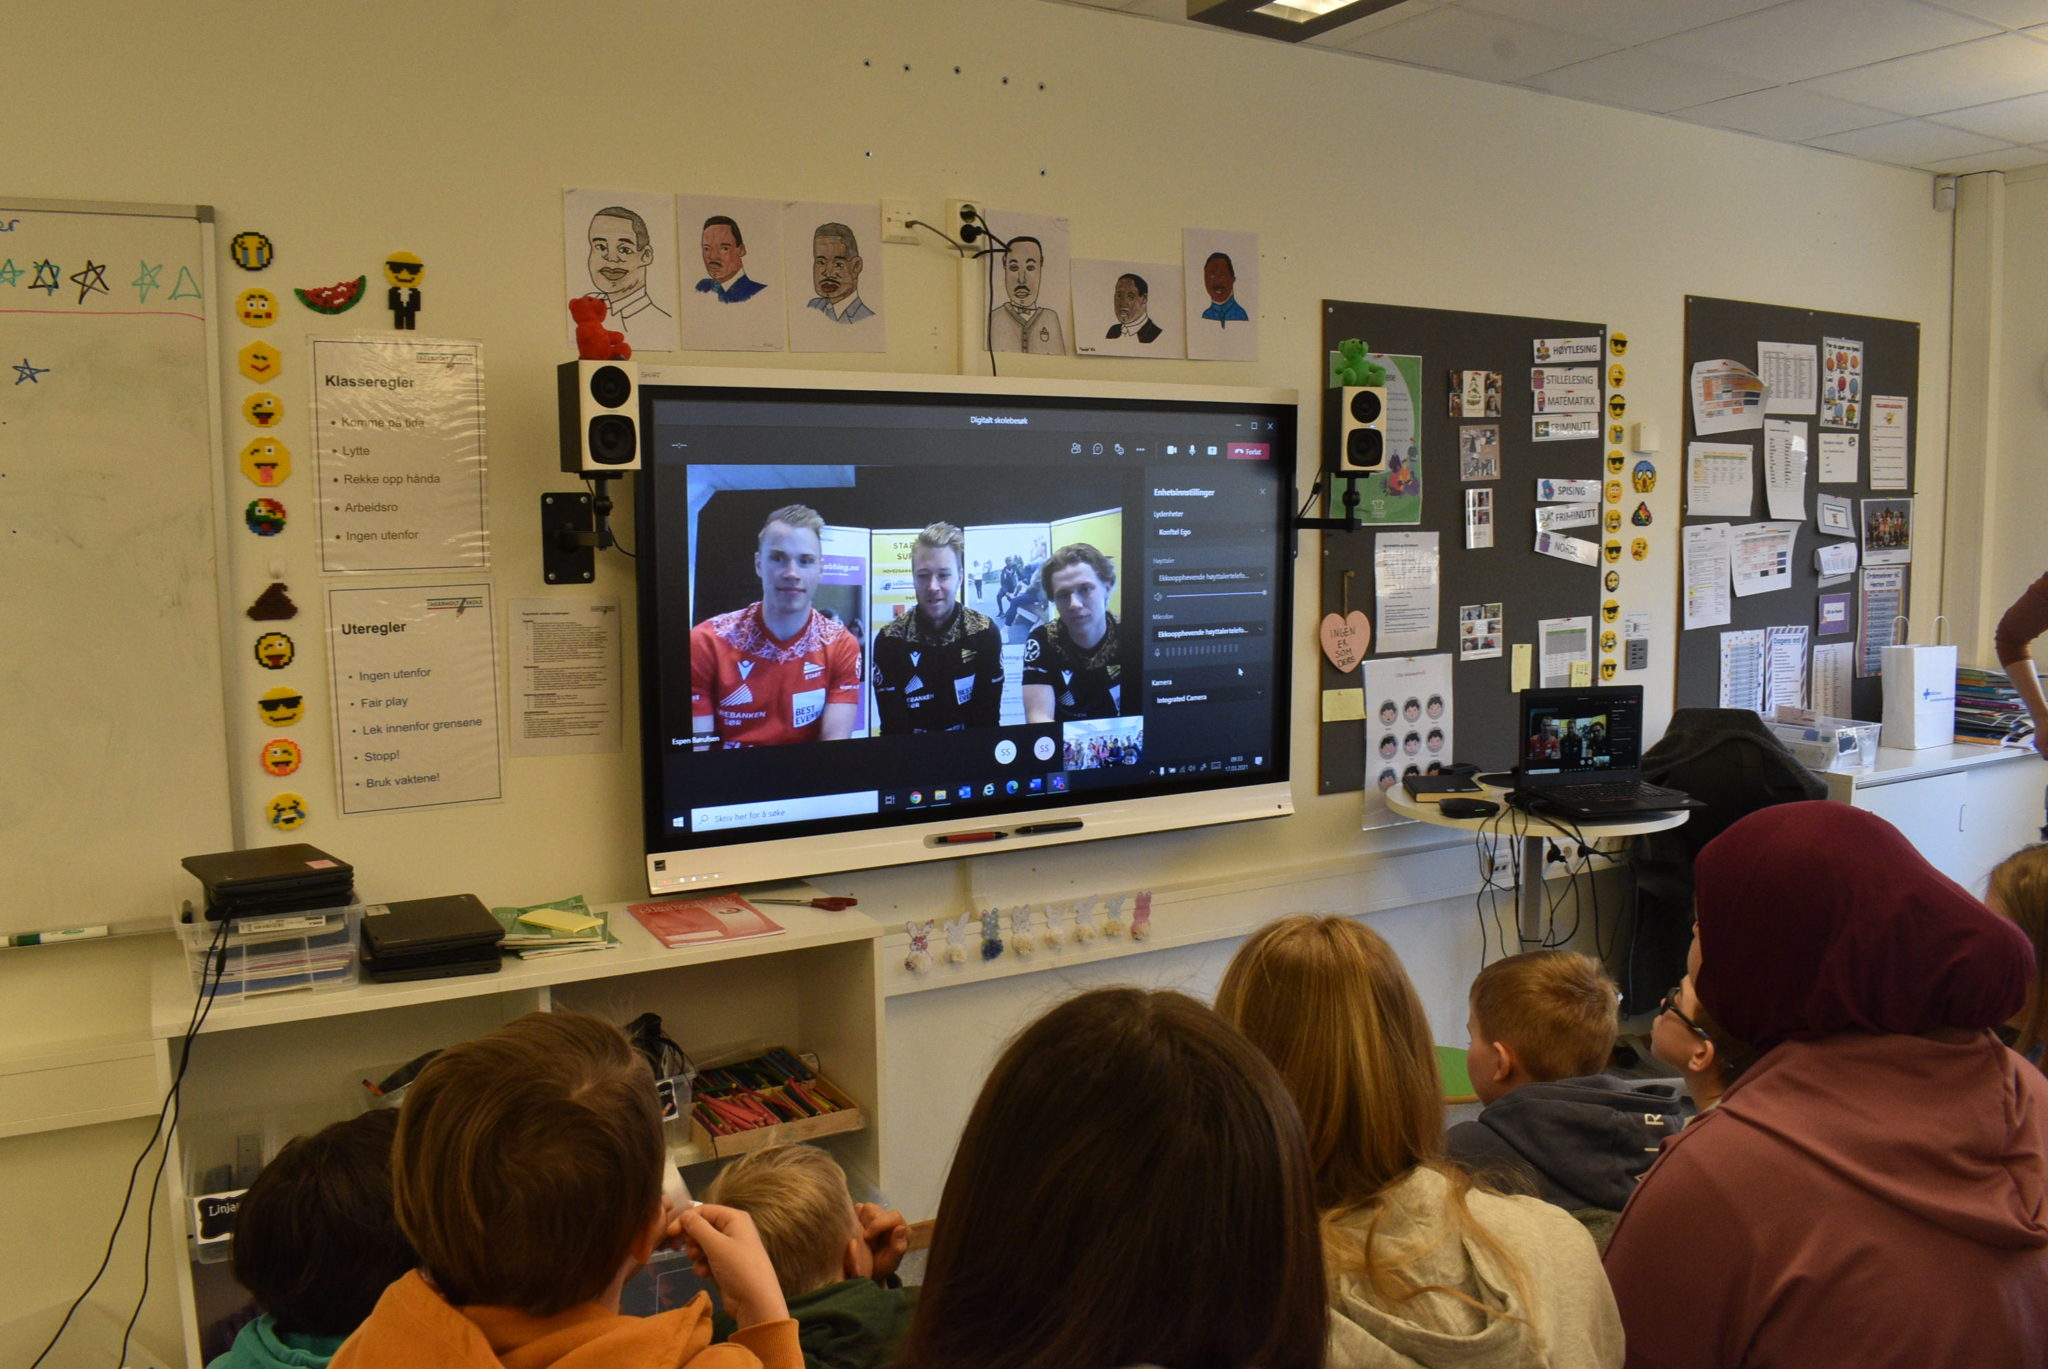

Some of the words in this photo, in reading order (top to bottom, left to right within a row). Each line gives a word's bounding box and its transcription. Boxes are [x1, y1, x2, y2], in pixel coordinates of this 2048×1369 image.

[1552, 344, 1597, 355] HØYTLESING
[325, 374, 415, 390] Klasseregler
[1545, 374, 1594, 385] STILLELESING
[1547, 395, 1595, 406] MATEMATIKK
[341, 416, 384, 428] Komme
[970, 415, 993, 426] Digitalt
[342, 446, 370, 459] Lytte
[344, 474, 379, 485] Rekke
[383, 476, 403, 488] opp
[406, 473, 441, 484] hånda
[1557, 486, 1586, 496] SPISING
[344, 502, 399, 513] Arbeidsro
[1555, 508, 1596, 522] FRIMINUTT
[346, 531, 377, 543] Ingen
[380, 530, 419, 541] utenfor
[341, 621, 407, 637] Uteregler
[1330, 625, 1356, 638] INGEN
[1337, 639, 1348, 648] ER
[1335, 648, 1352, 658] SOM
[359, 670, 391, 683] Ingen
[393, 668, 431, 680] utenfor
[360, 698, 383, 709] Fair
[385, 696, 409, 711] play
[795, 705, 816, 717] BEST
[362, 725, 384, 736] Lek
[386, 720, 430, 734] innenfor
[432, 717, 483, 734] grensene
[672, 737, 691, 746] Espen
[364, 750, 400, 765] Stopp!
[366, 777, 392, 789] Bruk
[395, 772, 440, 787] vaktene!
[715, 814, 733, 823] Skriv
[734, 812, 748, 821] her
[749, 811, 761, 819] for
[761, 810, 767, 818] å
[768, 809, 786, 817] søke
